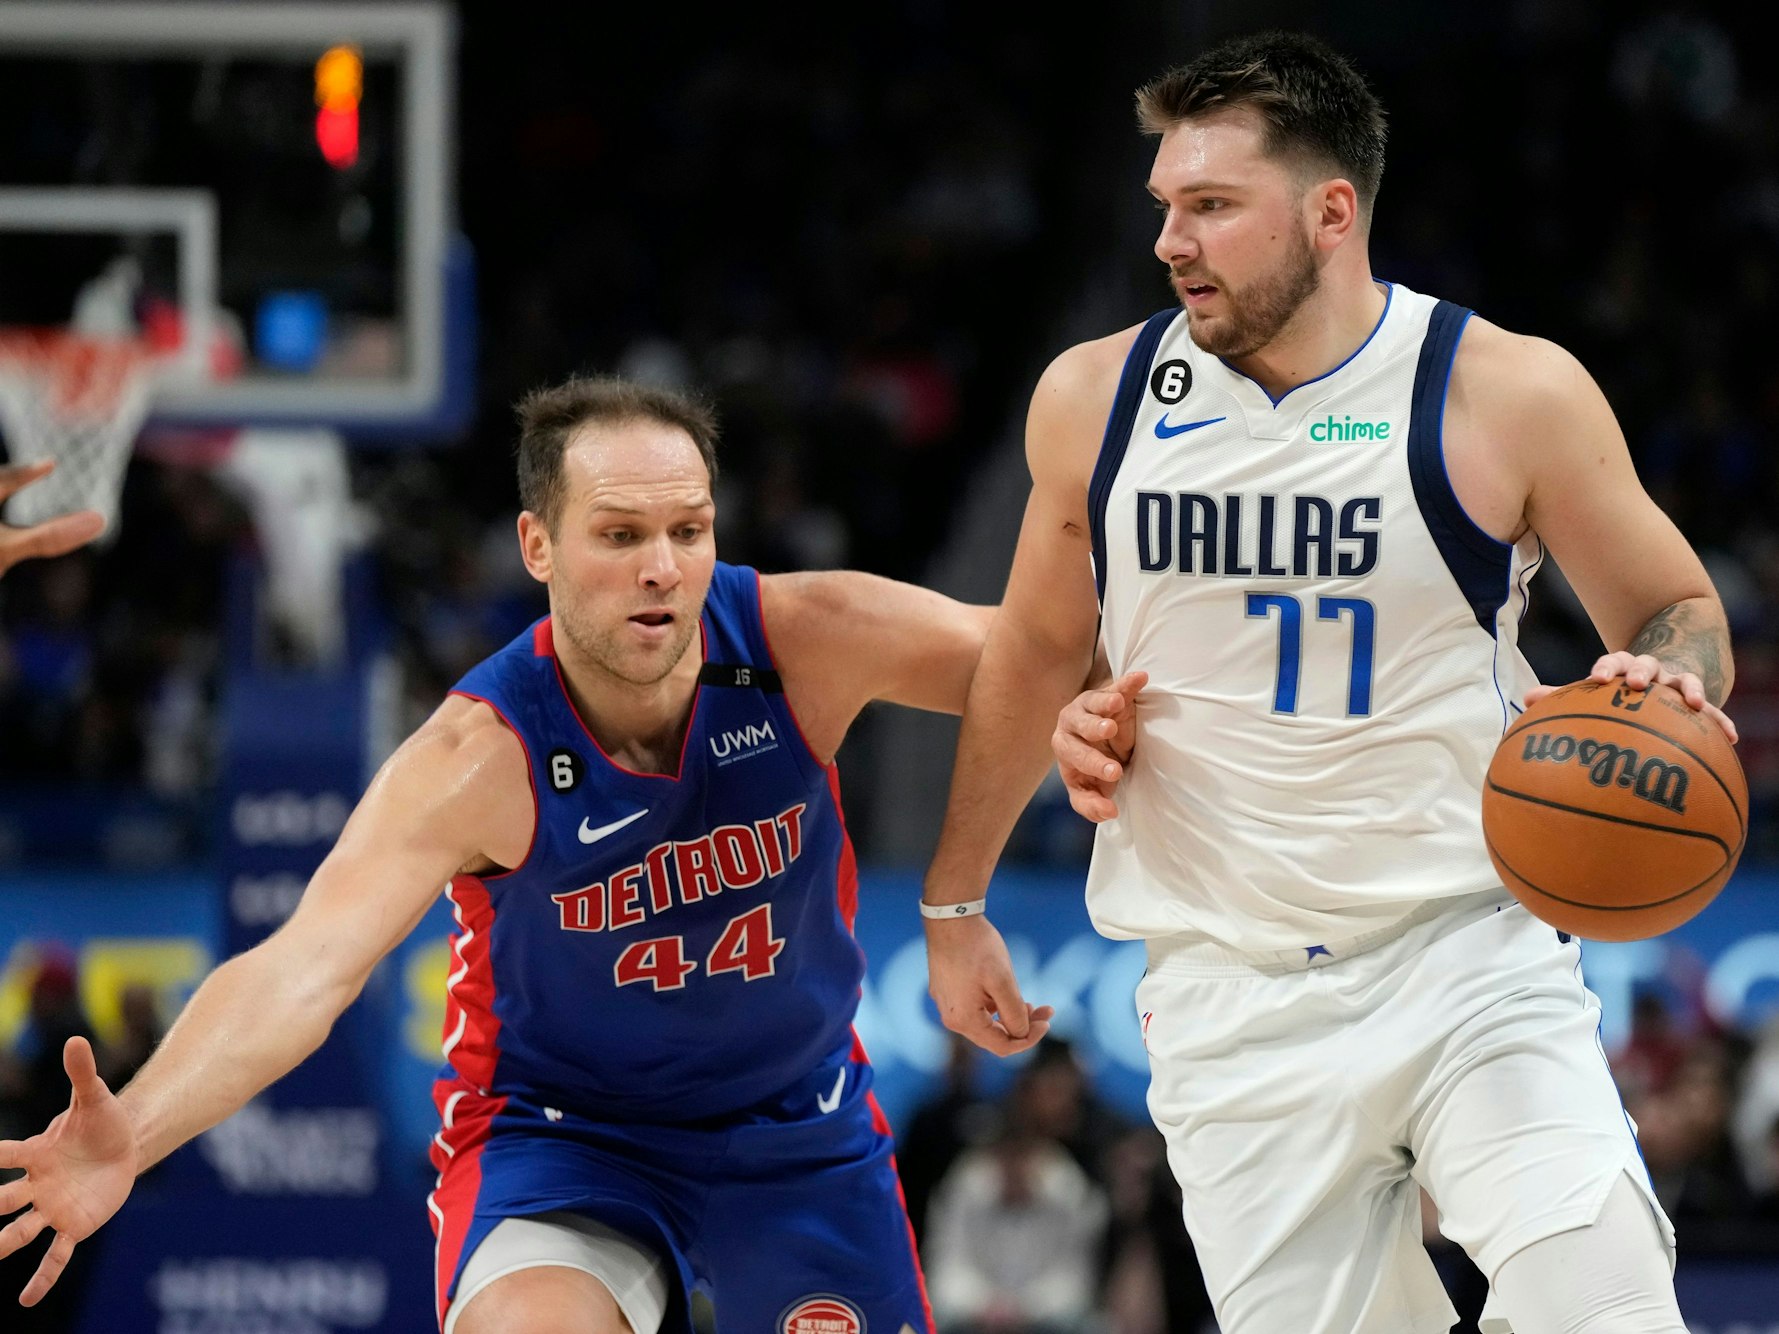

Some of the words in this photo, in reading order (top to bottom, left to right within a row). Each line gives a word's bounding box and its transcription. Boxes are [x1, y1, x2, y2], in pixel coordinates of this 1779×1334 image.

[1160, 365, 1185, 400] 6
[1310, 415, 1390, 442] chime
[1135, 489, 1384, 580] DALLAS
[735, 668, 751, 685] 16
[1244, 590, 1377, 718] 77
[709, 720, 776, 757] UWM
[552, 754, 574, 789] 6
[1522, 732, 1690, 815] Wilson
[551, 803, 807, 932] DETROIT
[613, 902, 786, 993] 44
